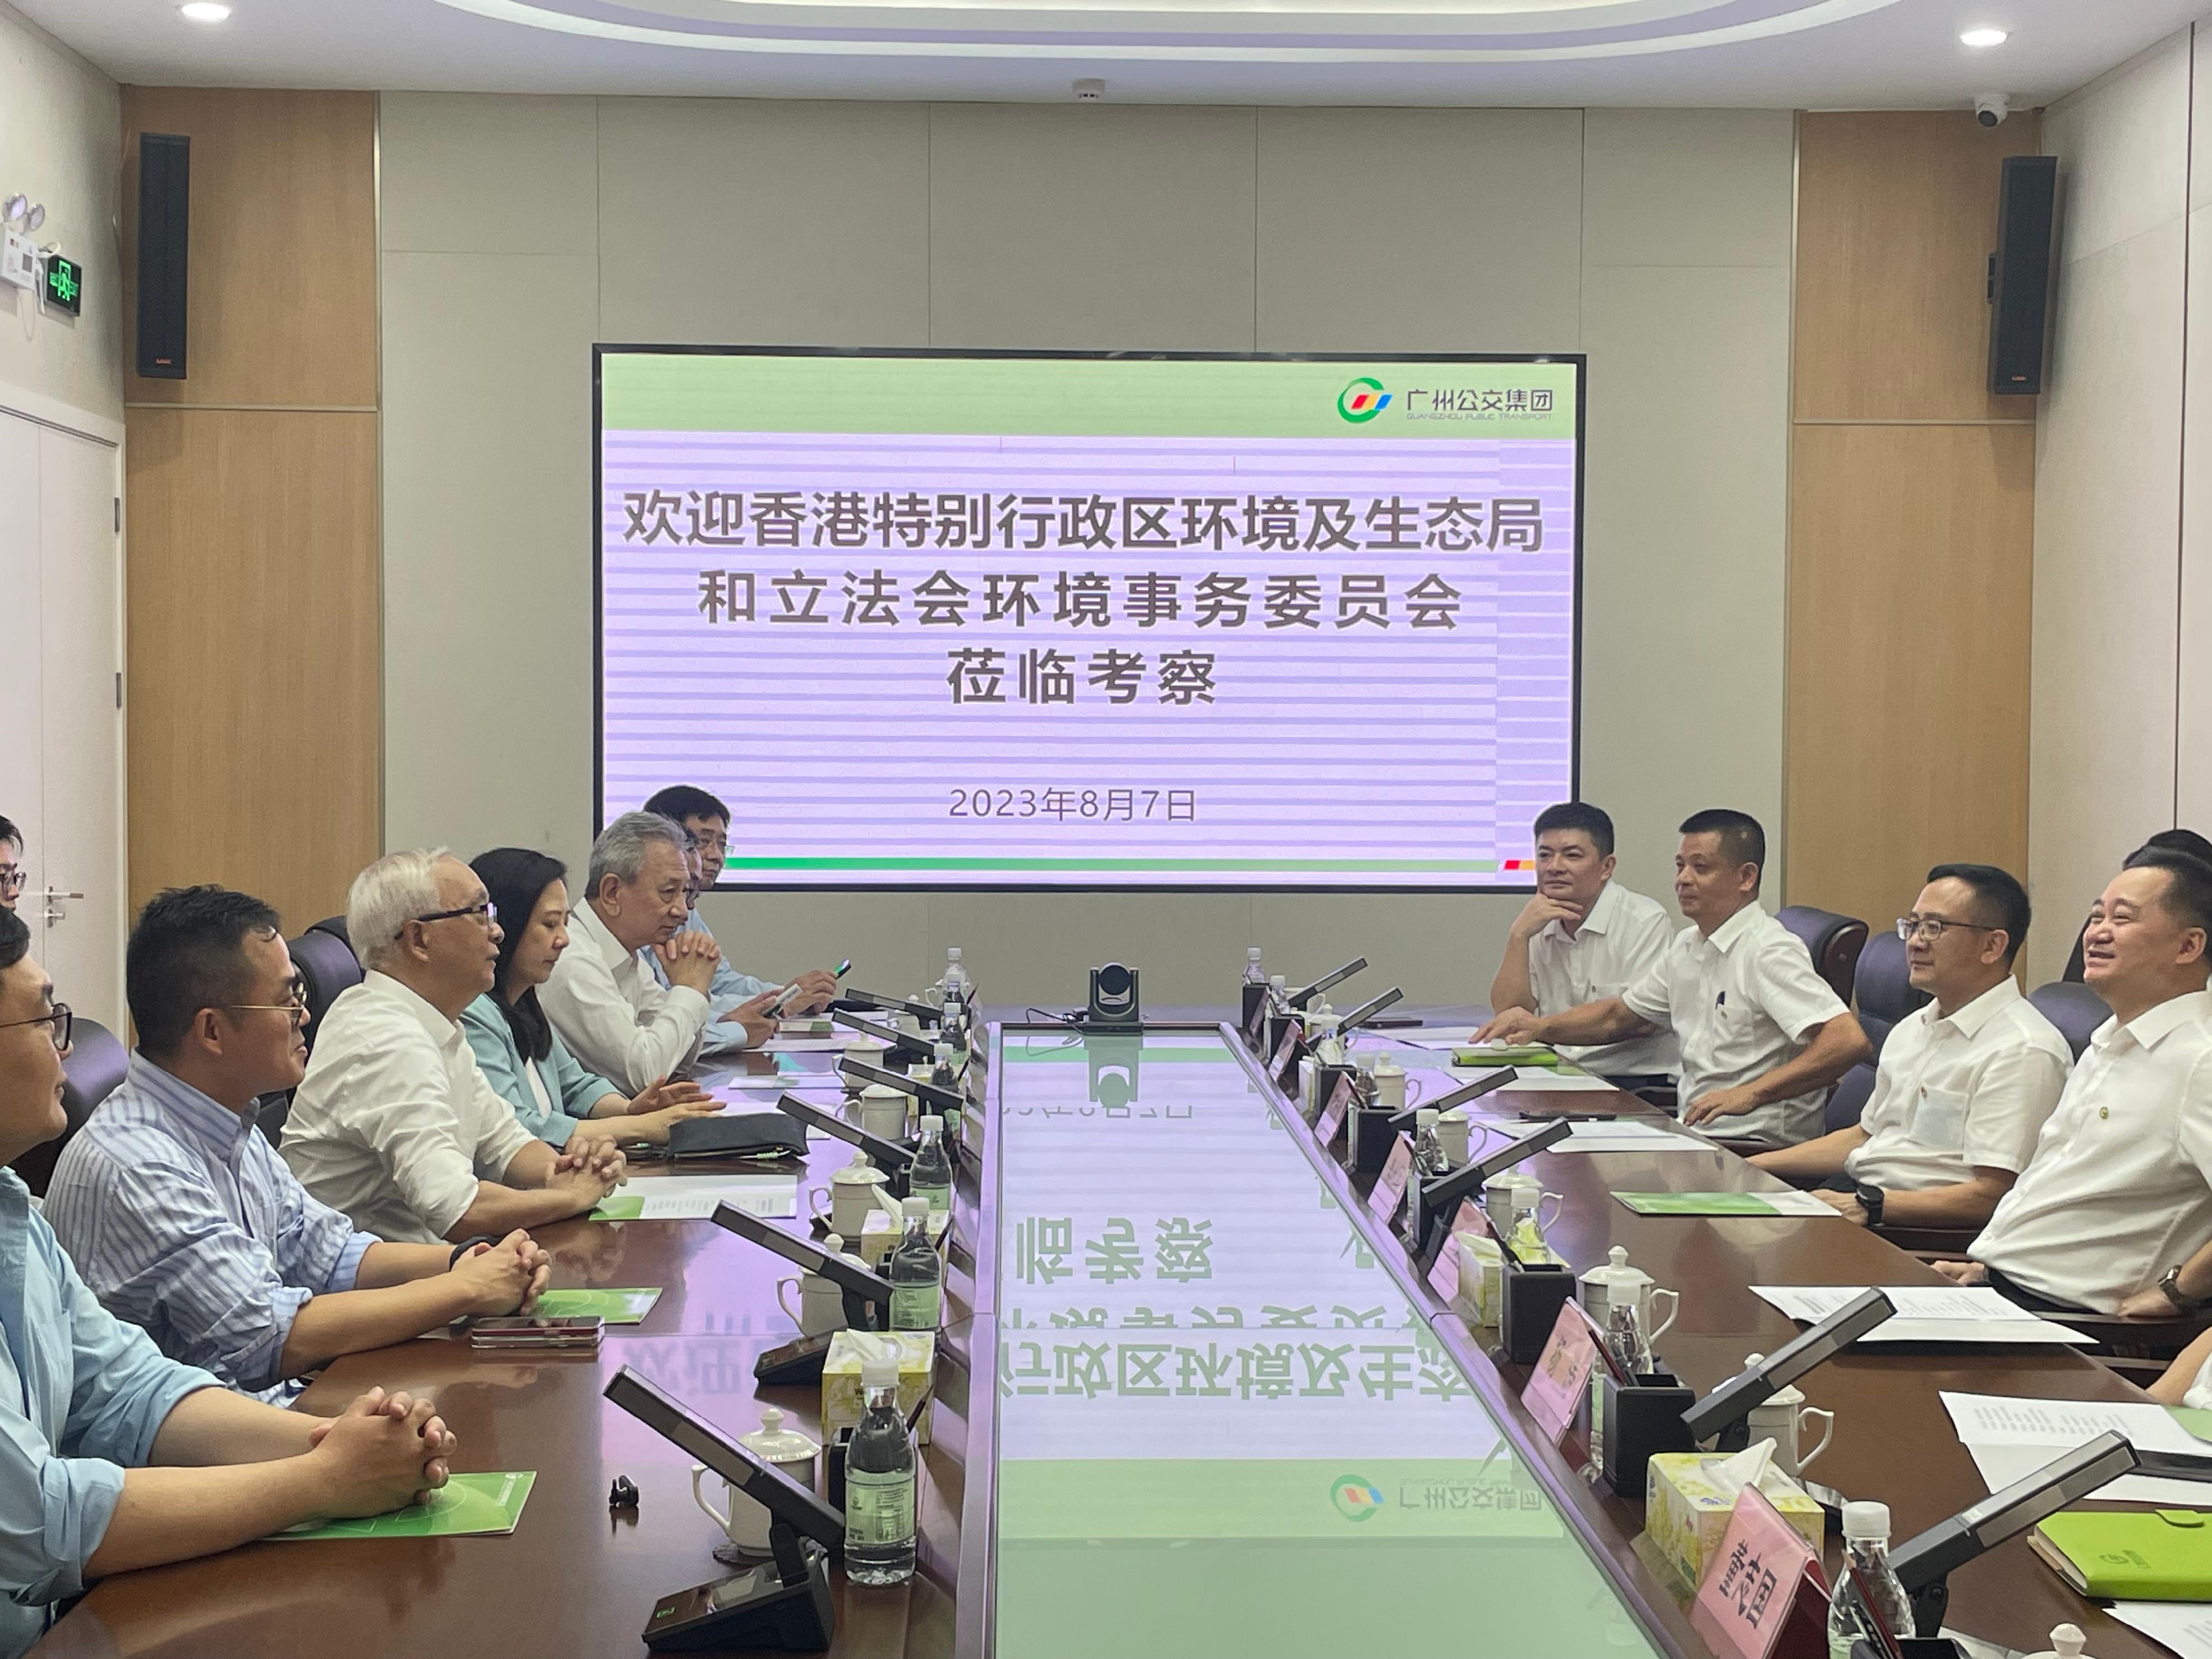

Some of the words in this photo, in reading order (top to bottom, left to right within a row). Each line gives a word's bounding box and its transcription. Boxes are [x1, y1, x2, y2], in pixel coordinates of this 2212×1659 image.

[1407, 389, 1553, 411] 广州公交集团
[623, 489, 1542, 552] 欢迎香港特别行政区环境及生态局
[698, 569, 1463, 630] 和立法会环境事务委员会
[946, 648, 1215, 705] 莅临考察
[950, 787, 1195, 821] 2023年8月7日
